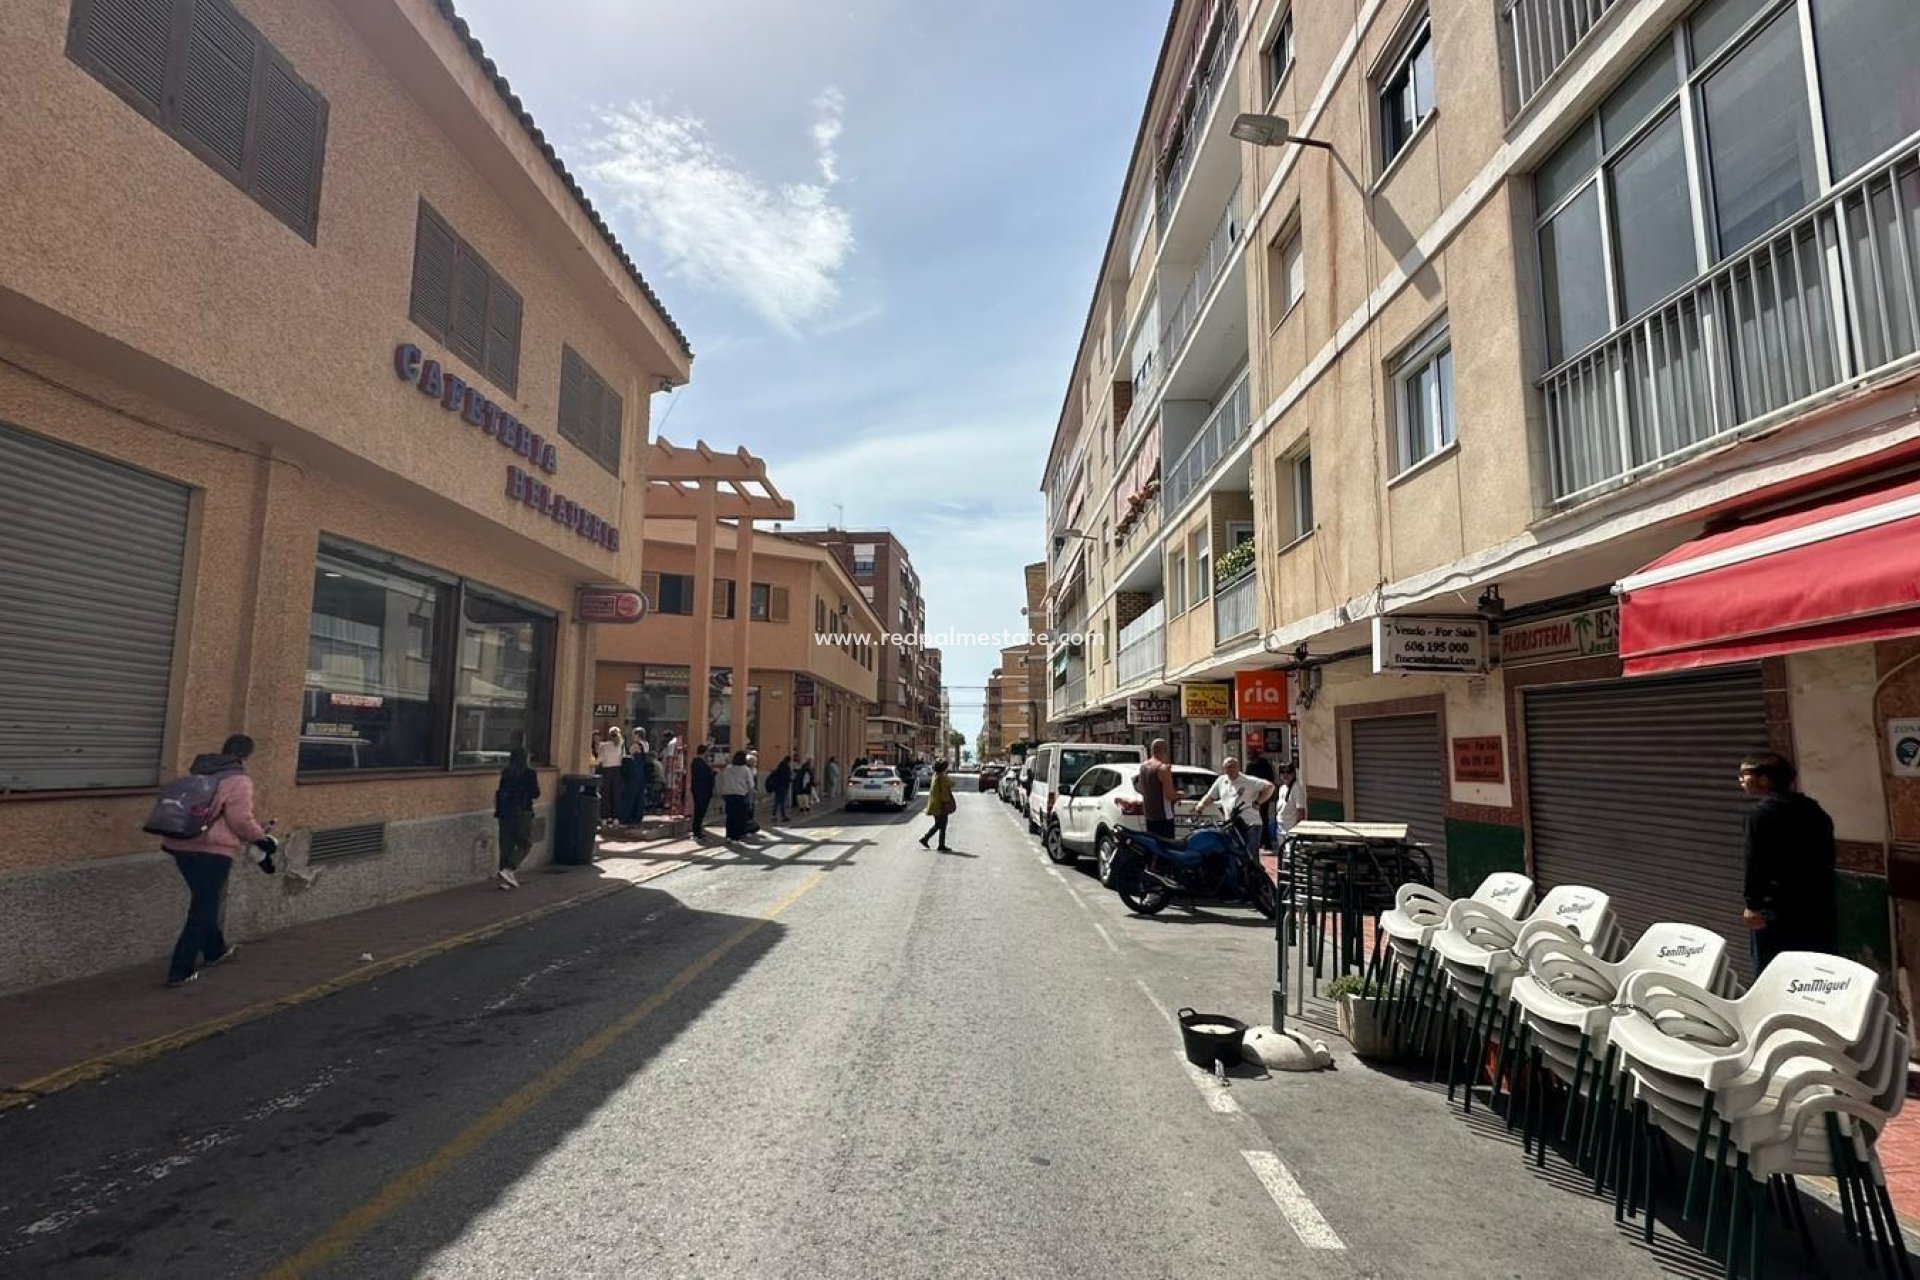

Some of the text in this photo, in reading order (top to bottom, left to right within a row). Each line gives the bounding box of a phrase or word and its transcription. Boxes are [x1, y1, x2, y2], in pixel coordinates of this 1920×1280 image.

[394, 343, 557, 475] CAFETERIA
[505, 465, 619, 552] HELADERIA
[1394, 625, 1426, 636] Vendo
[1435, 626, 1453, 637] For
[1456, 626, 1478, 638] Sale
[1503, 622, 1571, 654] FLORISTERIA
[1405, 641, 1469, 653] 606 195 000
[1244, 680, 1279, 703] ria
[597, 704, 617, 713] ATM
